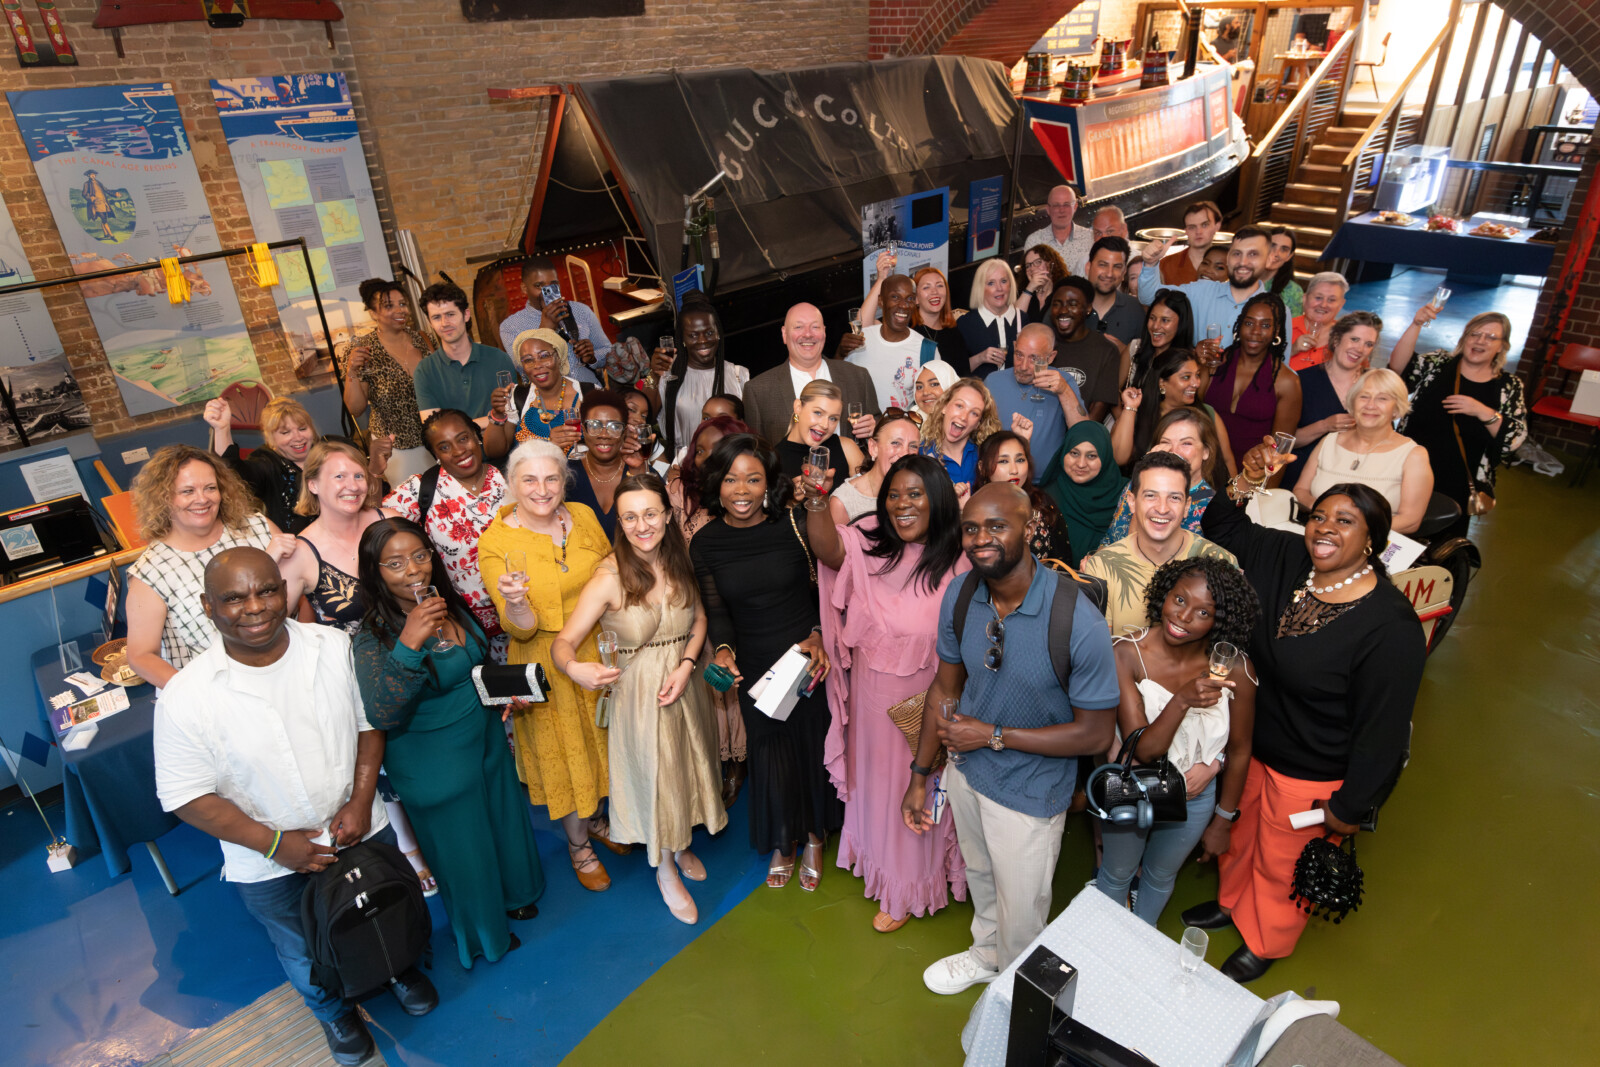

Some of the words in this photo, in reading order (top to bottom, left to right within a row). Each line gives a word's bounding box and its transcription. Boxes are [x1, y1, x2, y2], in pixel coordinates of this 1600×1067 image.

[259, 140, 307, 152] TRANSPORT
[310, 146, 347, 154] NETWORK
[58, 156, 77, 167] THE
[81, 156, 117, 168] CANAL
[120, 163, 140, 171] AGE
[144, 162, 177, 172] BEGINS
[897, 240, 918, 248] TRACTOR
